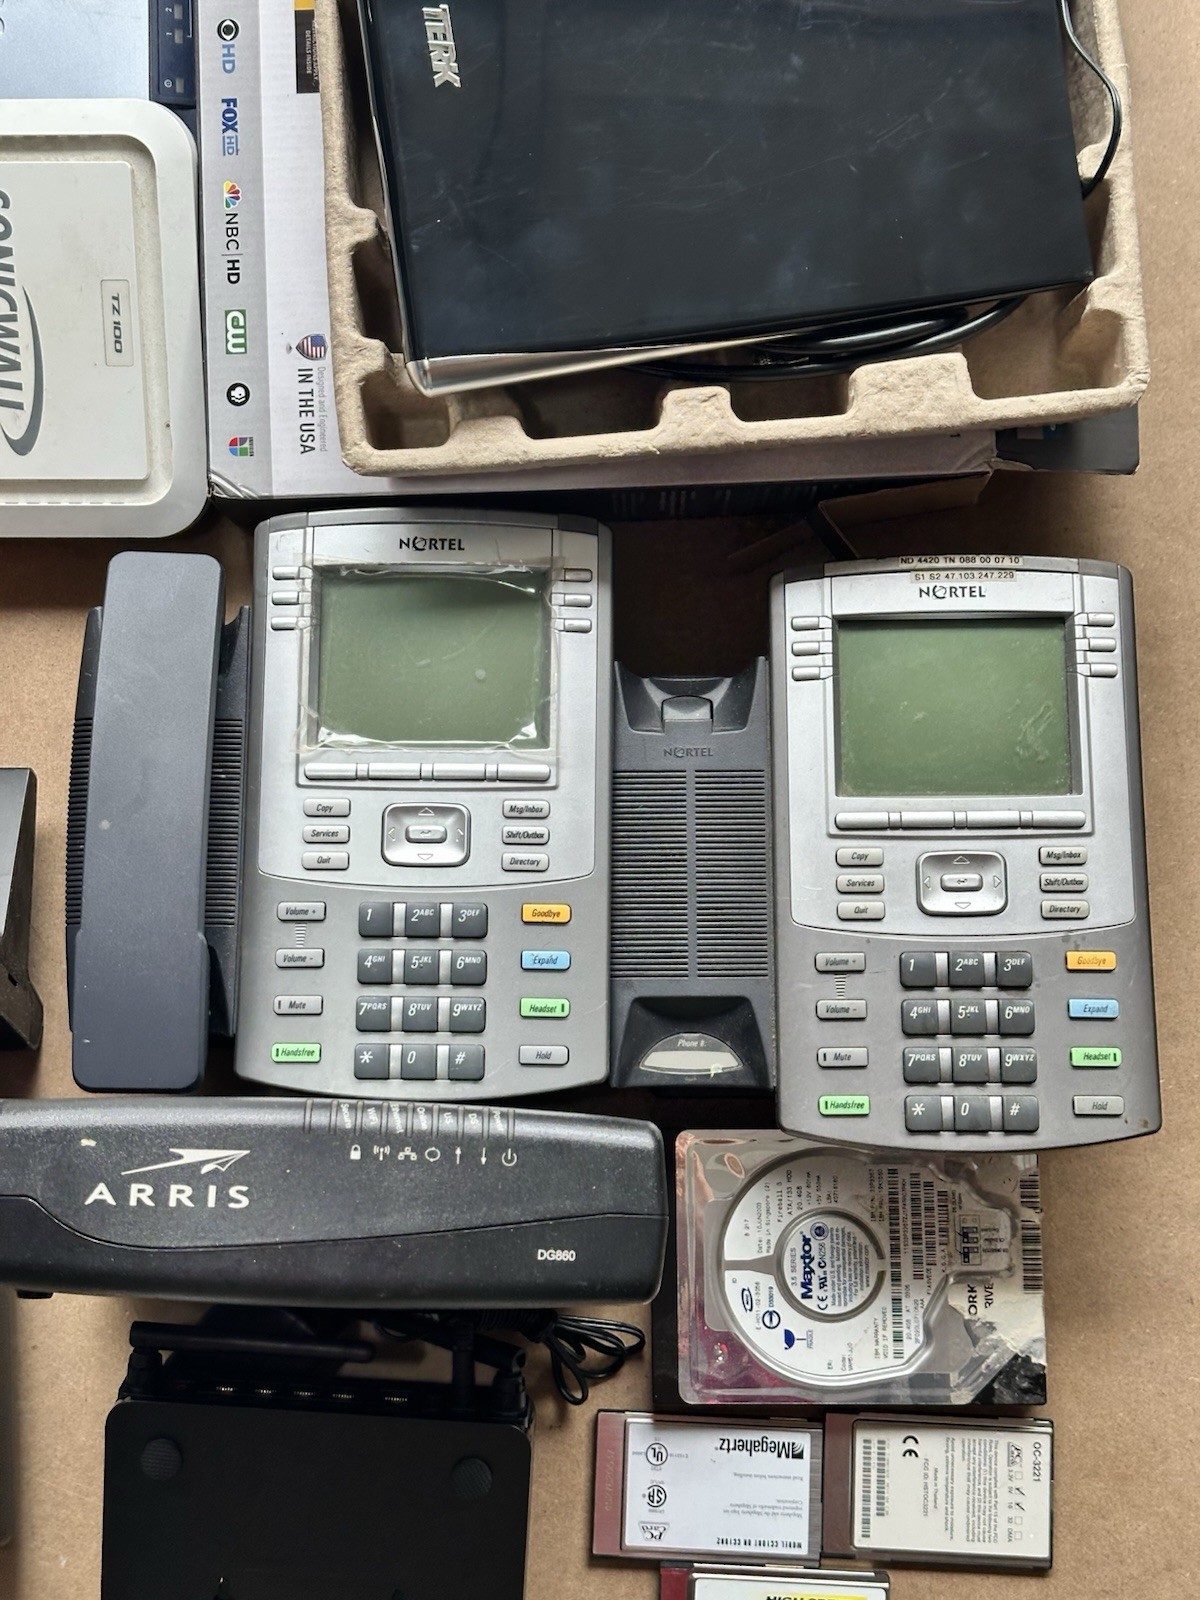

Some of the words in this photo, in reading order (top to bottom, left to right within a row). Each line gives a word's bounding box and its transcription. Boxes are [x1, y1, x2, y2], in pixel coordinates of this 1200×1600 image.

[222, 44, 235, 74] HD
[221, 98, 239, 133] FOX
[225, 135, 236, 155] HD
[225, 213, 239, 251] NBC
[226, 260, 240, 285] HD
[111, 292, 120, 316] TZ
[113, 321, 122, 353] 100
[298, 368, 313, 383] IN
[316, 367, 326, 398] Designed
[299, 389, 314, 418] THE
[318, 400, 327, 413] and
[319, 414, 328, 452] Engineered
[299, 423, 316, 455] USA
[399, 536, 465, 551] NORTEL
[919, 585, 986, 599] NORTEL
[663, 747, 714, 758] NORTEL
[316, 804, 333, 813] Copy
[508, 804, 544, 815] Msg/Inbox
[311, 829, 339, 838] Services
[505, 830, 545, 840] Shift/Outbox
[317, 855, 331, 865] Quit
[851, 852, 869, 861] Copy
[1046, 851, 1081, 861] Msg/Inbox
[509, 857, 541, 868] Directory
[846, 879, 875, 888] Services
[1044, 877, 1084, 887] Shift/Outbox
[285, 906, 309, 916] Volume
[366, 909, 372, 921] 1
[531, 909, 561, 919] Goodbye
[854, 906, 868, 915] Quit
[1049, 904, 1080, 915] Directory
[283, 953, 306, 963] Volume
[532, 955, 558, 966] Expand
[825, 957, 849, 966] Volume
[1077, 956, 1107, 967] Goodbye
[909, 958, 915, 971] 1
[288, 1000, 306, 1009] Mute
[529, 1004, 557, 1014] Headset
[825, 1005, 849, 1014] Volume
[1083, 1004, 1108, 1015] Expand
[281, 1047, 315, 1058] Handsfree
[535, 1050, 552, 1060] Hold
[833, 1052, 852, 1061] Mute
[1083, 1052, 1111, 1061] Headset
[830, 1100, 865, 1110] Handsfree
[1092, 1101, 1108, 1111] Hold
[368, 1108, 378, 1125] WiFi
[444, 1112, 453, 1124] US
[469, 1113, 479, 1126] DS
[84, 1182, 250, 1208] ARRIS
[537, 1249, 576, 1261] DG860
[968, 1284, 978, 1316] ORK
[719, 1436, 790, 1459] Megahertz
[1032, 1442, 1041, 1482] OC-3221
